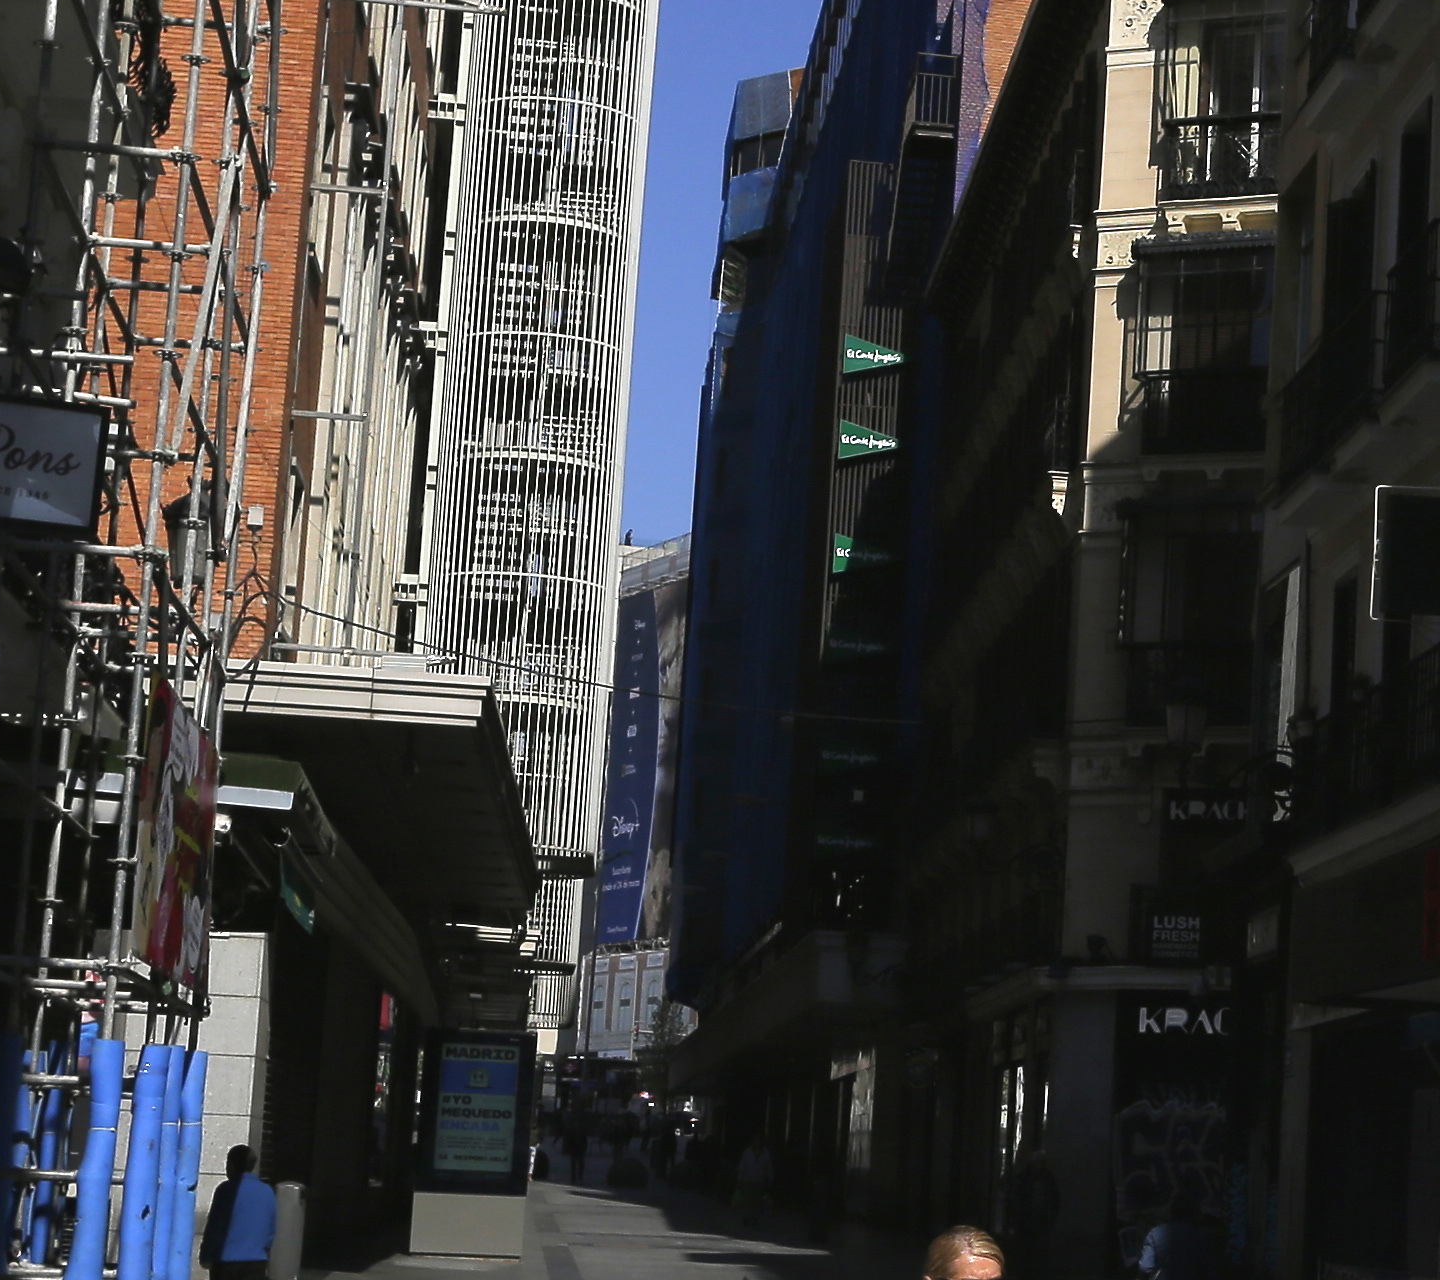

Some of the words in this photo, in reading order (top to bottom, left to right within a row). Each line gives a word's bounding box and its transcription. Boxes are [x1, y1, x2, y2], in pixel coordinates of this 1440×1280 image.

[1154, 916, 1200, 929] LUSH
[1153, 930, 1200, 942] FRESH
[445, 1046, 517, 1061] MADRID
[442, 1094, 472, 1105] #YO
